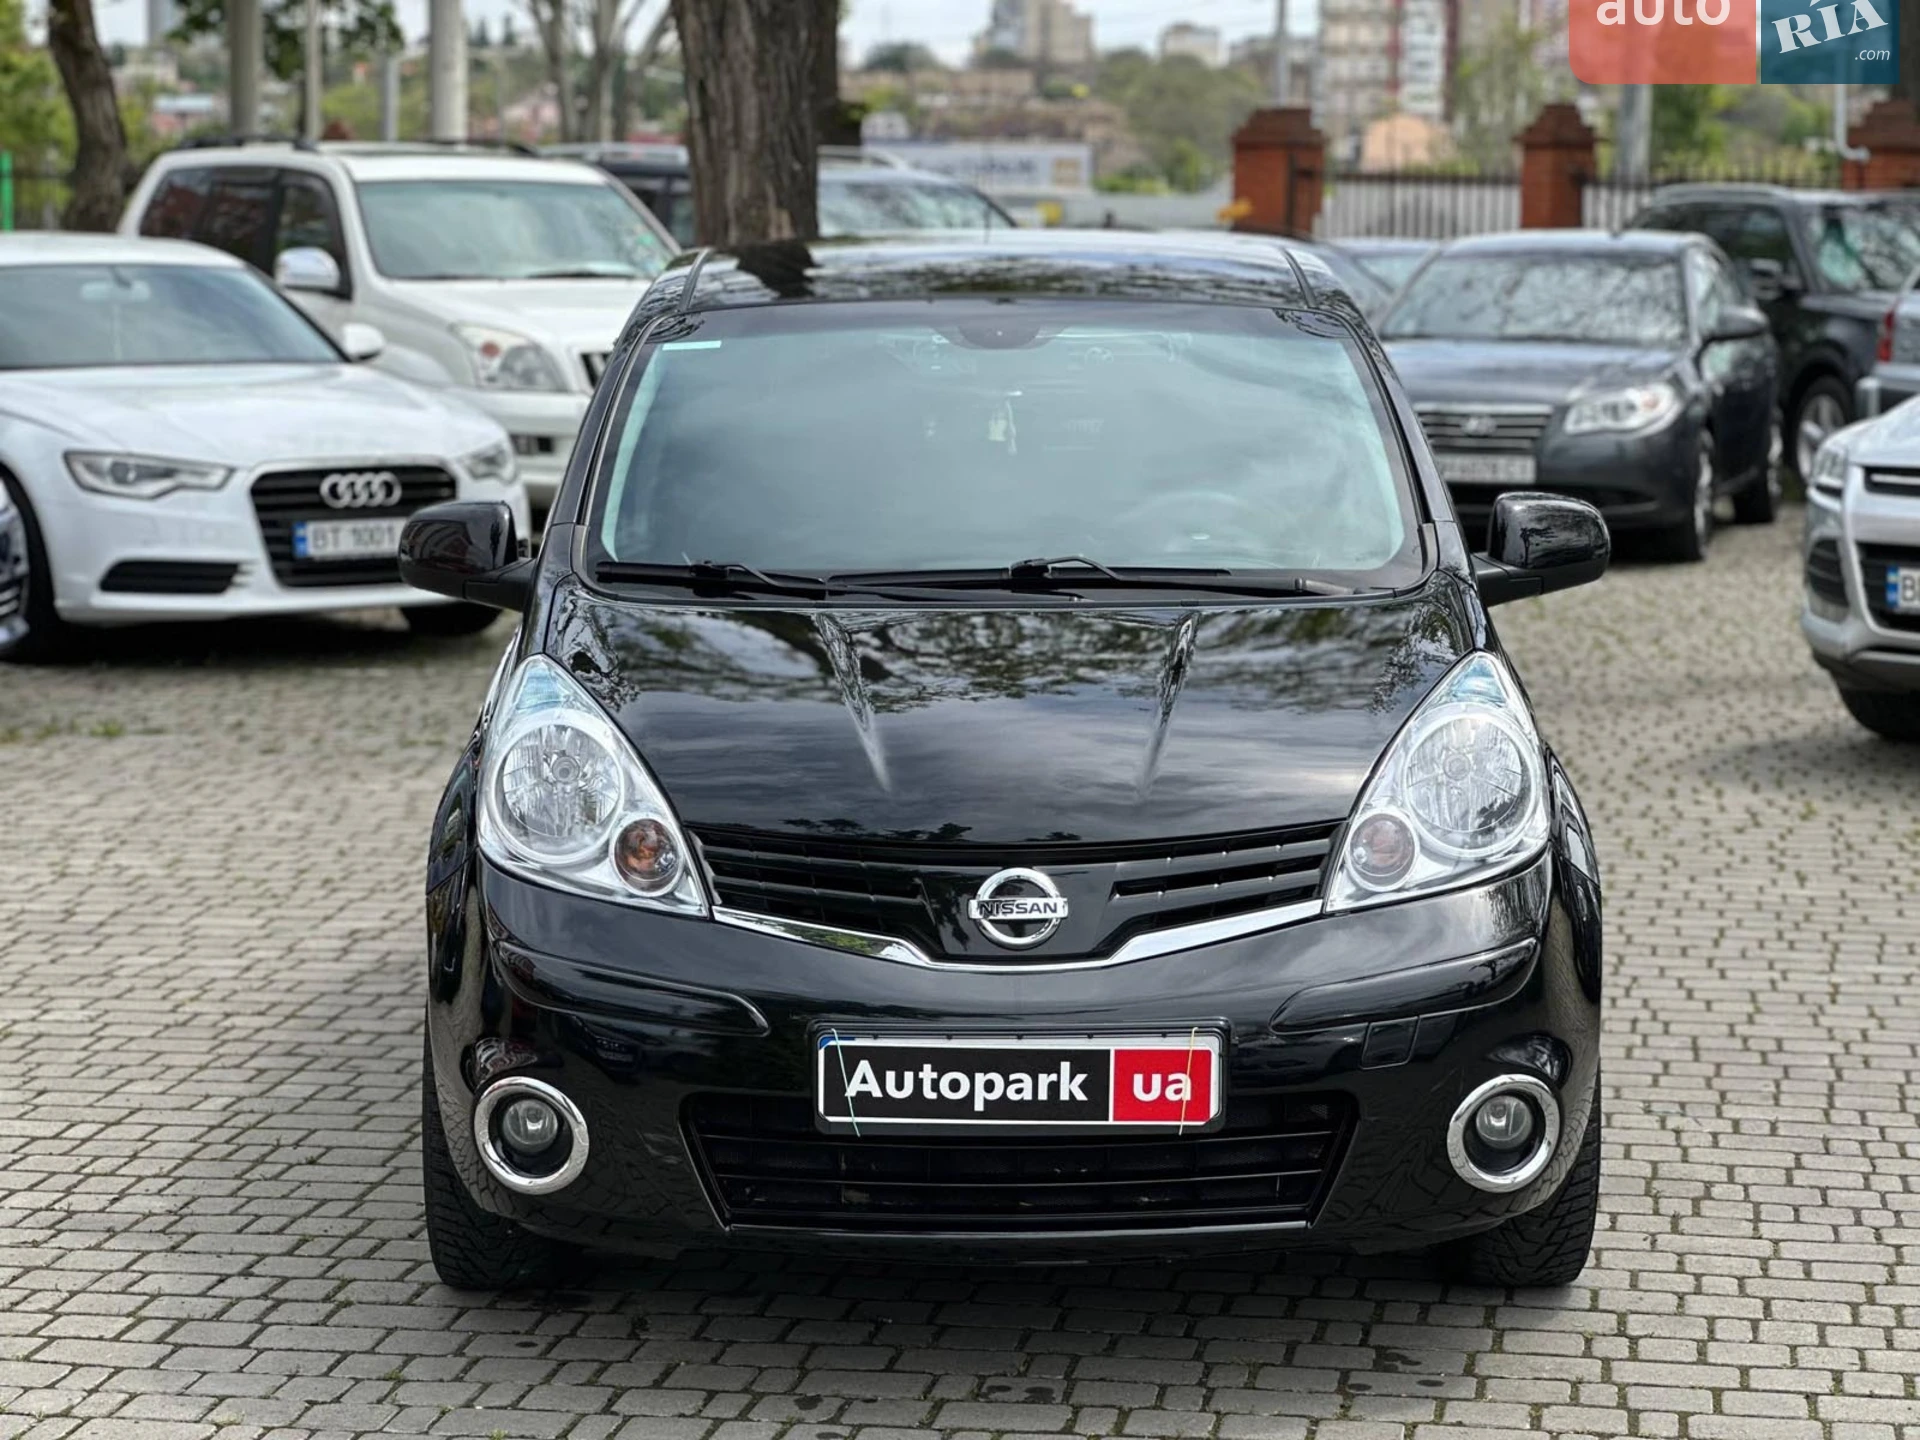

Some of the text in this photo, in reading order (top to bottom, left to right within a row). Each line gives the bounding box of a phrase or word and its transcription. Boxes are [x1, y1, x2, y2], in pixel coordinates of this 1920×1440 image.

[979, 901, 1058, 916] NISSAN
[845, 1059, 1193, 1112] Autopark ua
